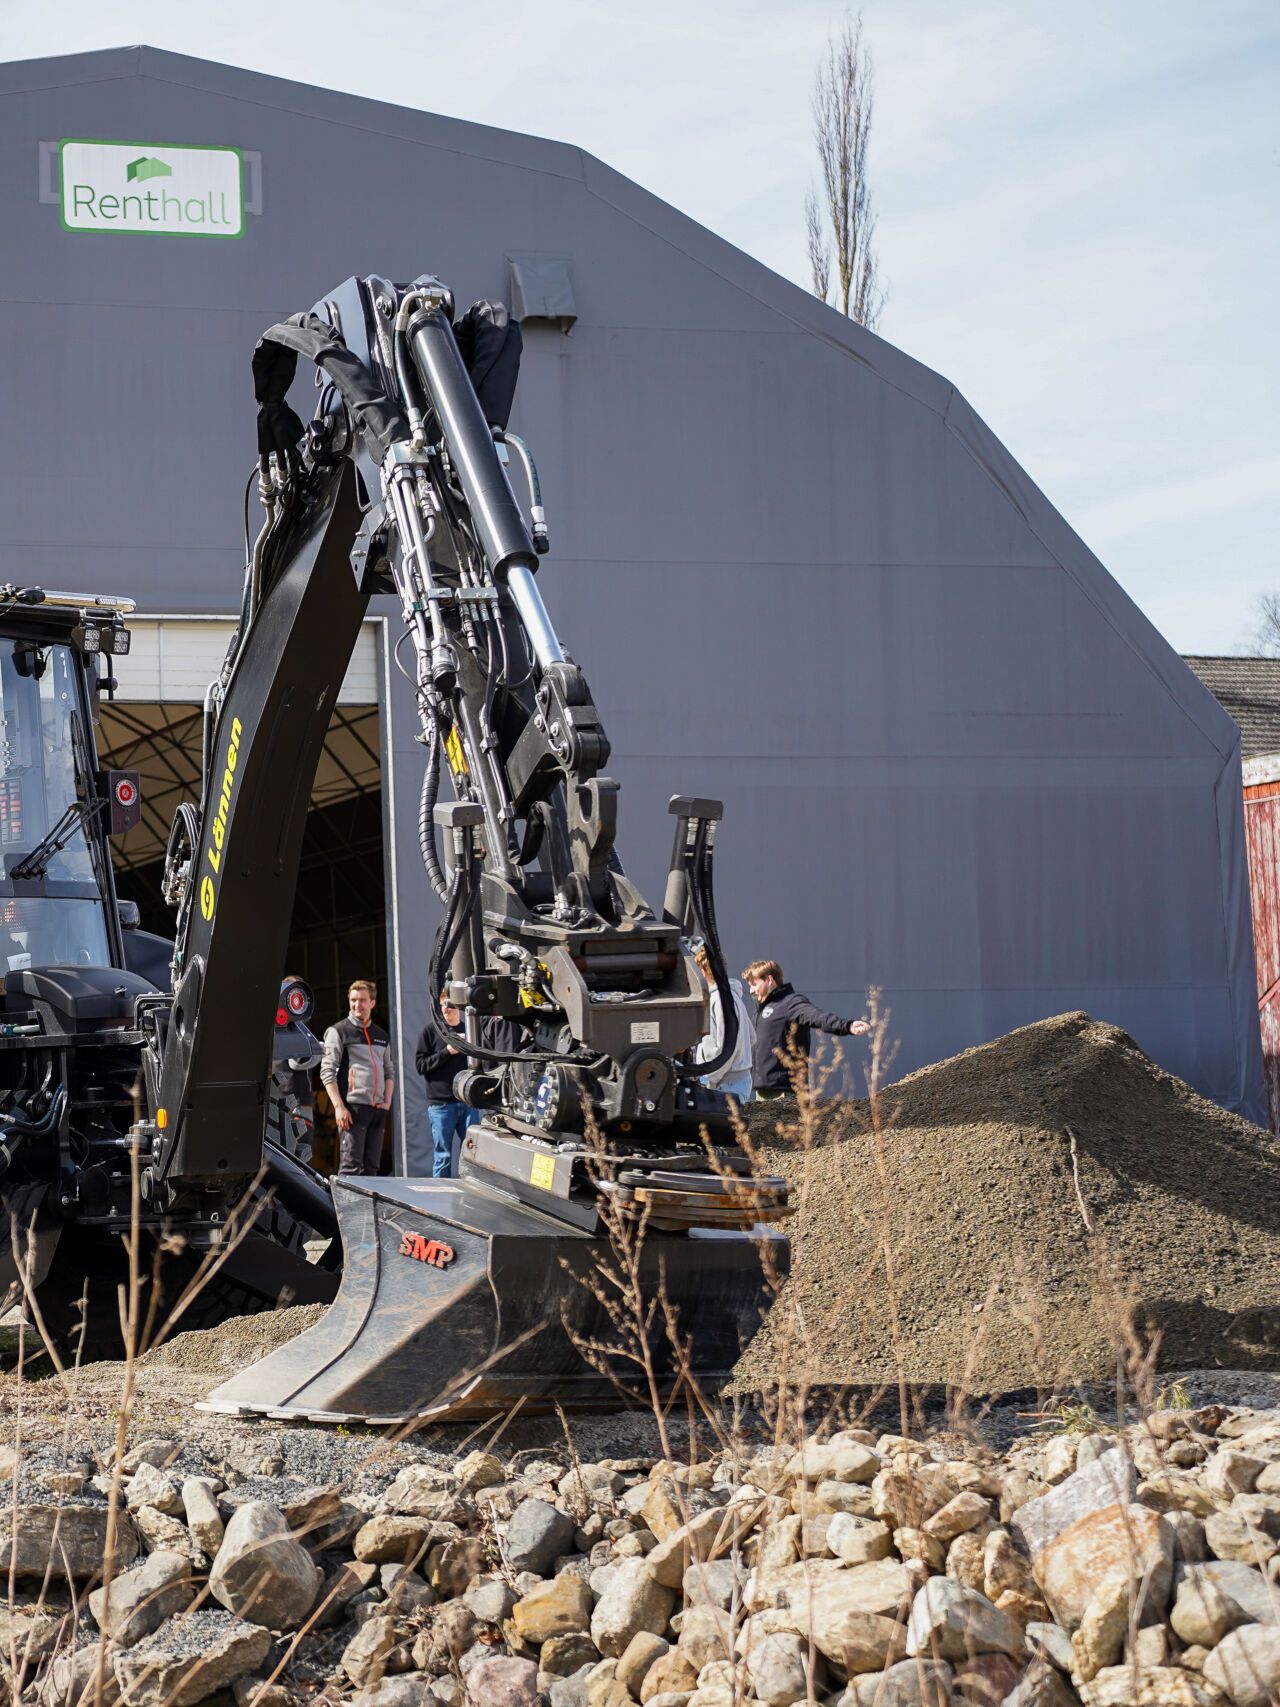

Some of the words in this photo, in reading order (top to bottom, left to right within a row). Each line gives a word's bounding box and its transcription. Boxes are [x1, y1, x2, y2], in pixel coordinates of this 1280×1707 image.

[73, 184, 232, 225] Renthall
[207, 717, 243, 875] Lännen
[399, 1230, 456, 1269] SMP
